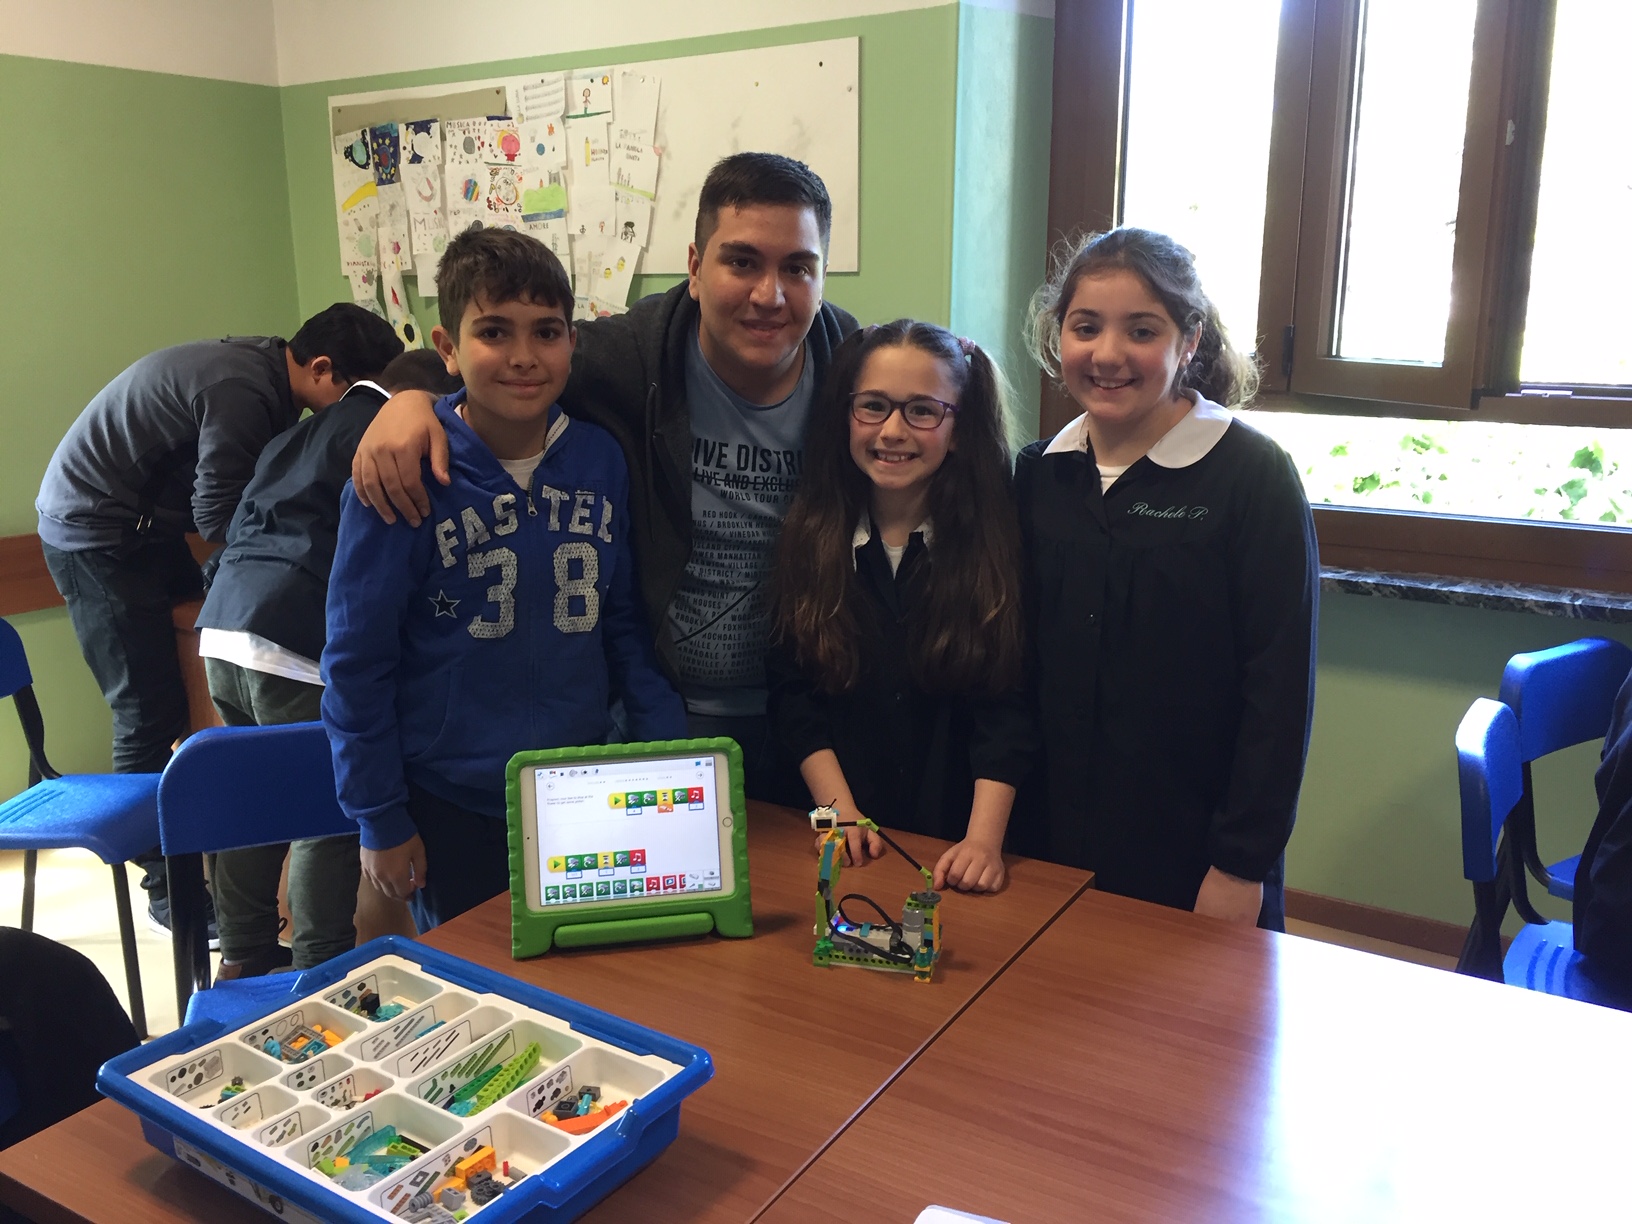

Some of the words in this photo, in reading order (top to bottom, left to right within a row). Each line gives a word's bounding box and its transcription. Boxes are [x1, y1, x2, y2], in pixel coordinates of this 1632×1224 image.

[691, 438, 729, 469] IVE
[693, 467, 721, 487] LIVE
[724, 473, 750, 490] AND
[720, 489, 751, 502] WORLD
[754, 493, 779, 504] TOUR
[702, 510, 716, 518] RED
[719, 511, 737, 519] HOOK
[717, 521, 753, 529] BROOKLYN
[729, 530, 760, 538] VINEGAR
[717, 552, 762, 561] MANHATTAN
[728, 562, 759, 570] VILLAGE
[699, 567, 733, 578] DISTRICT
[708, 590, 730, 600] POINT
[692, 598, 721, 609] HOUSES
